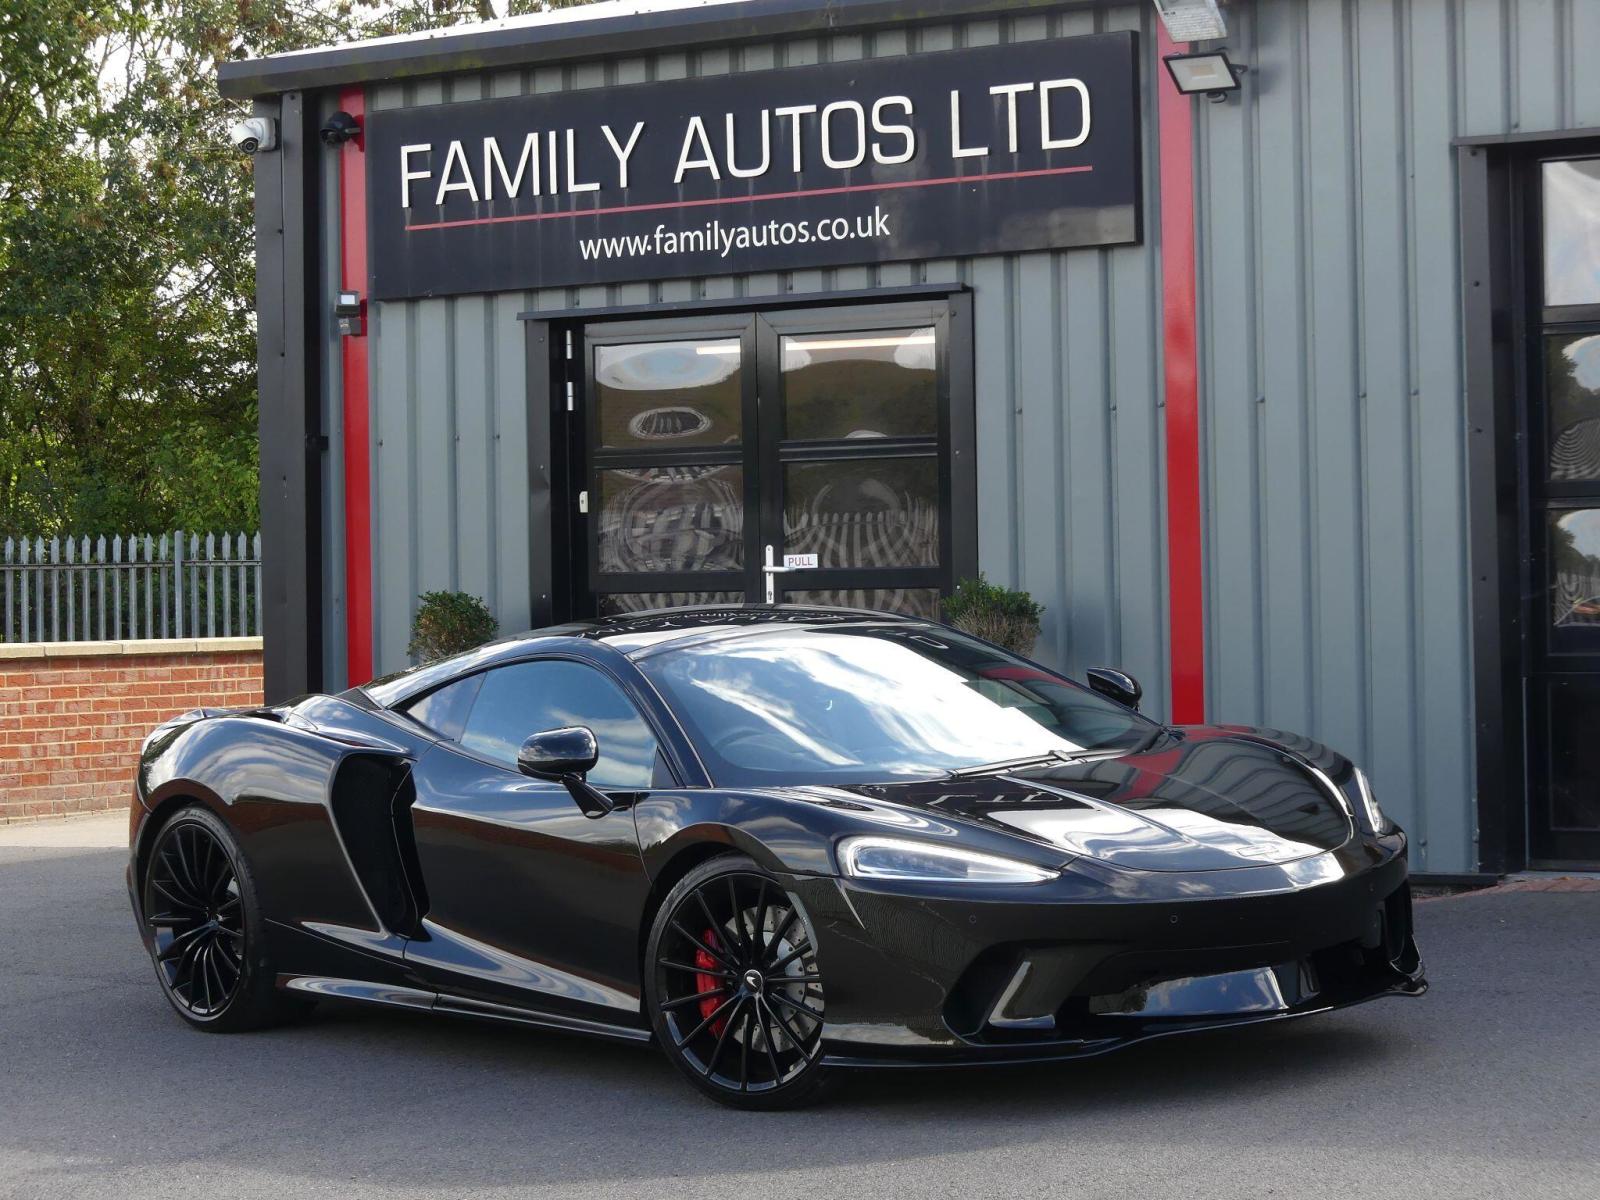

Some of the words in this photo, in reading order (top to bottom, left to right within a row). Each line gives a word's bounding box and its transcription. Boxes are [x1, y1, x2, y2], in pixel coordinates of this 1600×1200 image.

[400, 121, 645, 208] FAMILY
[673, 95, 915, 184] AUTOS
[950, 78, 1091, 159] LTD
[579, 205, 891, 260] www.familyautos.co.uk
[788, 556, 813, 567] PULL
